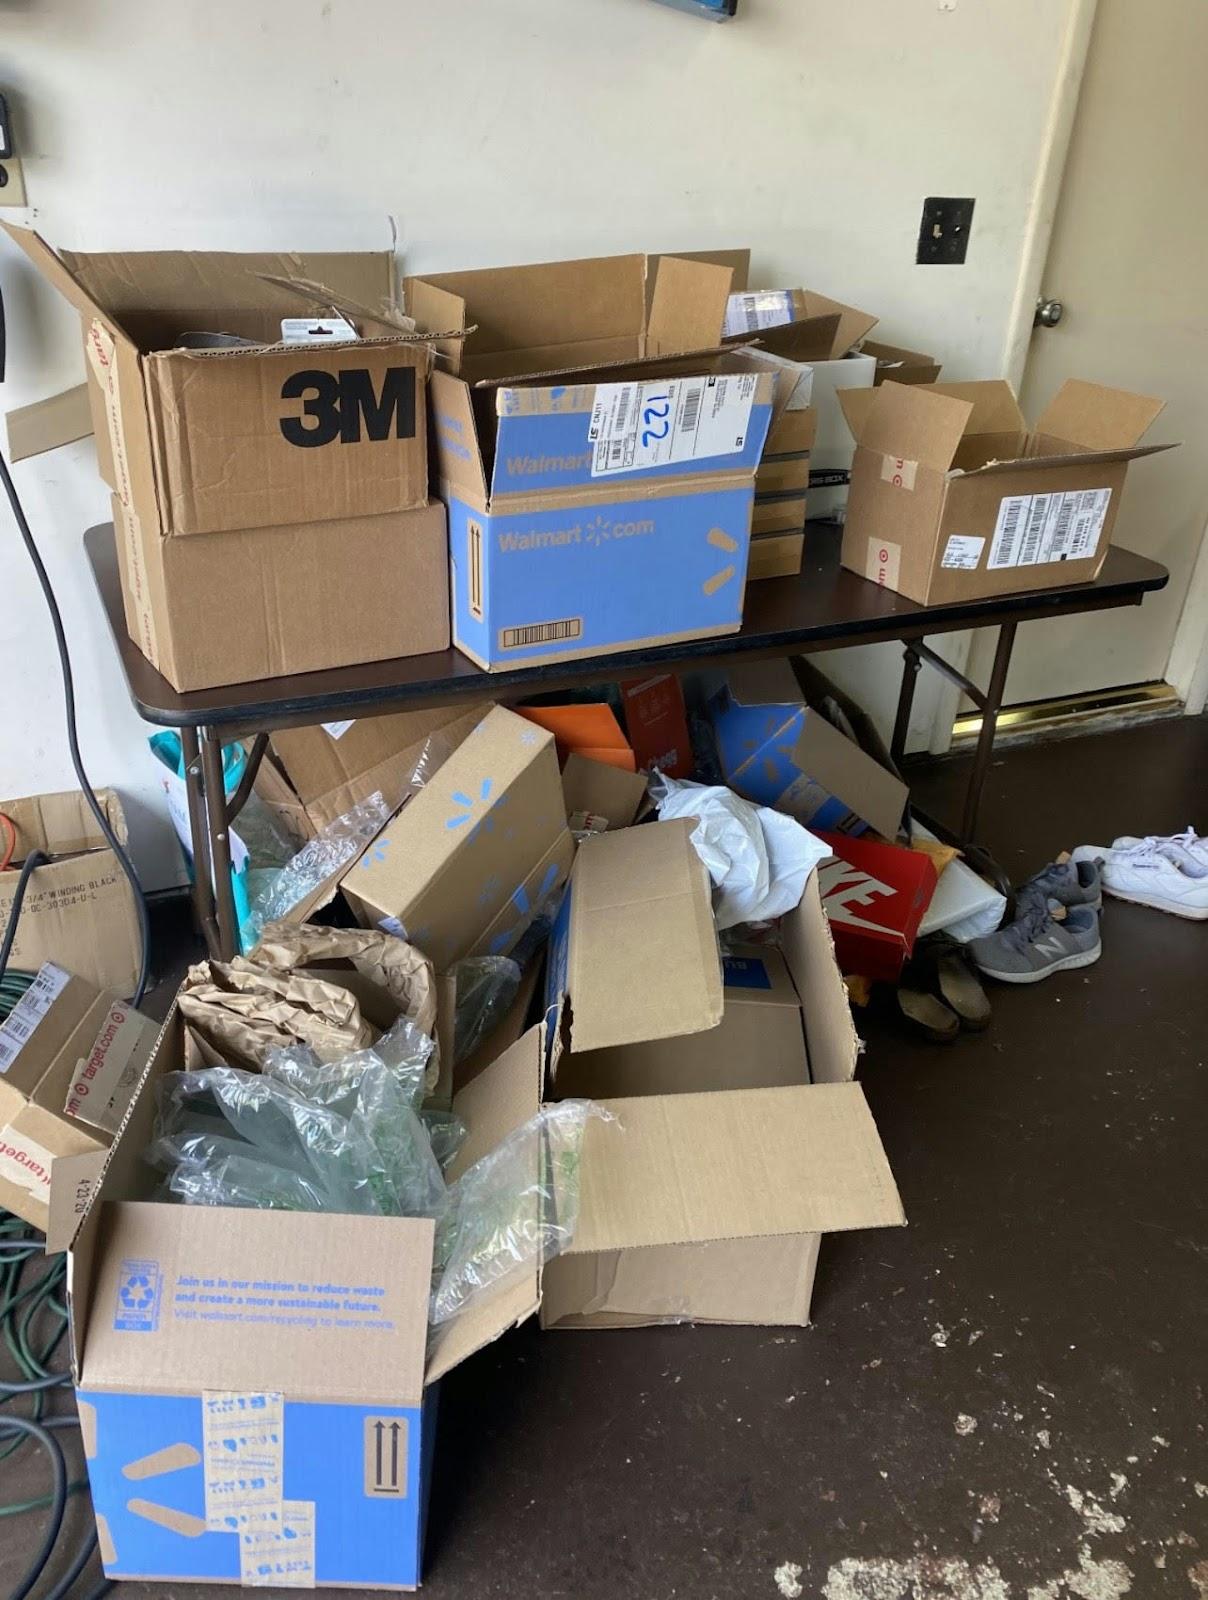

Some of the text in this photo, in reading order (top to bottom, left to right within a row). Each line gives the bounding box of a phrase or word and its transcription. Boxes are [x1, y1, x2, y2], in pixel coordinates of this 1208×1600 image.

[280, 366, 416, 448] 3M
[499, 524, 582, 552] Walmart
[88, 876, 118, 890] BLACK
[82, 1024, 119, 1080] target.com
[177, 1274, 385, 1296] Join us in our mission to reduce waste
[175, 1291, 196, 1303] and
[199, 1293, 234, 1304] create
[246, 1296, 274, 1306] more
[277, 1297, 340, 1311] sustainable
[342, 1299, 381, 1312] future.
[174, 1308, 197, 1320] Visit
[320, 1317, 333, 1328] to
[335, 1318, 361, 1329] learn
